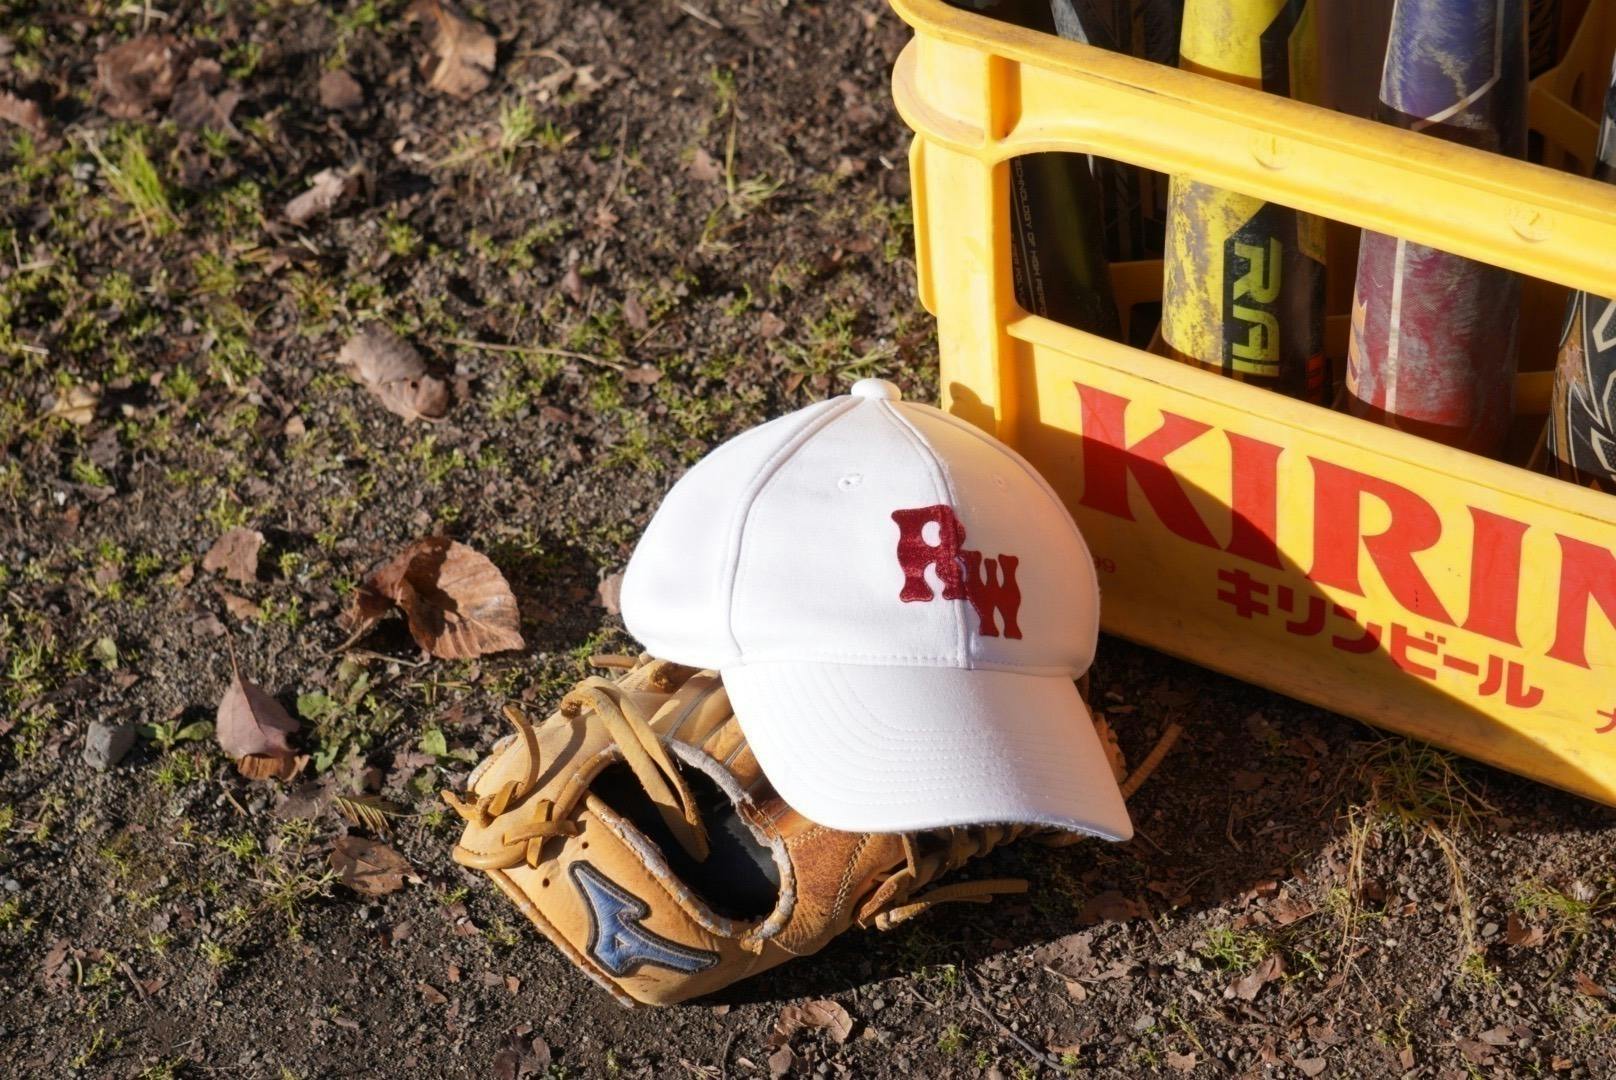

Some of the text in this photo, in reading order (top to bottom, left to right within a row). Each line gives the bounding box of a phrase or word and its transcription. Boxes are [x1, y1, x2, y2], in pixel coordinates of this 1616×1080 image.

[1216, 568, 1544, 709] キリンビール
